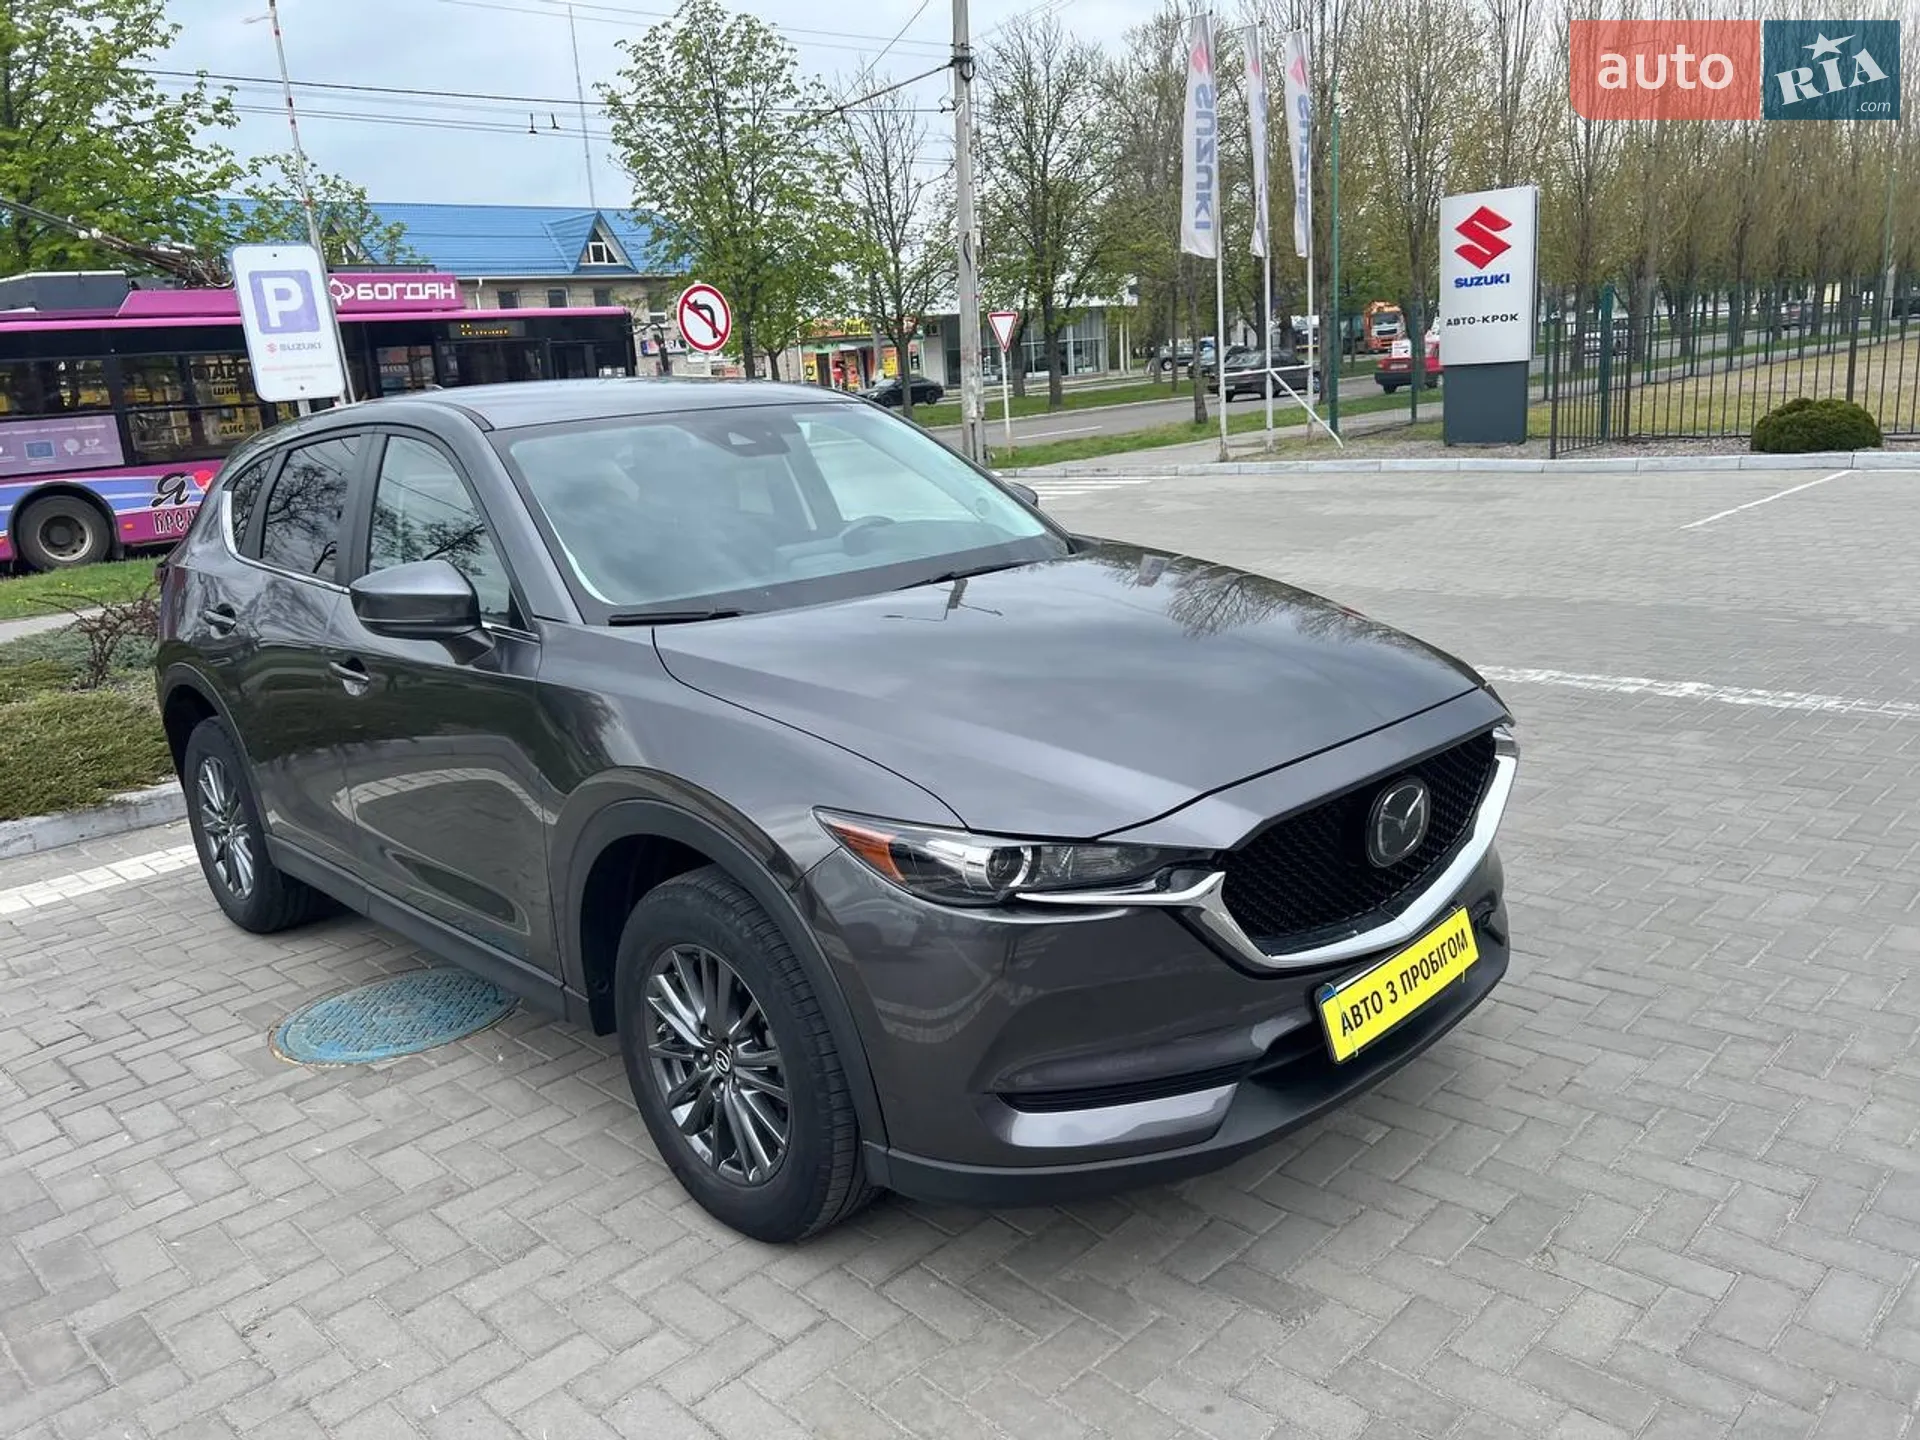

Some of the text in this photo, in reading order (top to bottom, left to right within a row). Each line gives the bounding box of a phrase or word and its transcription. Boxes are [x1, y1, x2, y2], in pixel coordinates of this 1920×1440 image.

[1194, 83, 1215, 230] SUZUKI
[357, 283, 456, 300] БОГДАН
[1454, 273, 1511, 288] SUZUKI
[260, 277, 304, 328] P
[1446, 313, 1519, 327] АВТО-КРОК
[152, 473, 190, 507] Я
[1340, 991, 1383, 1037] АВТО
[1399, 928, 1468, 996] ПРОБІГОМ
